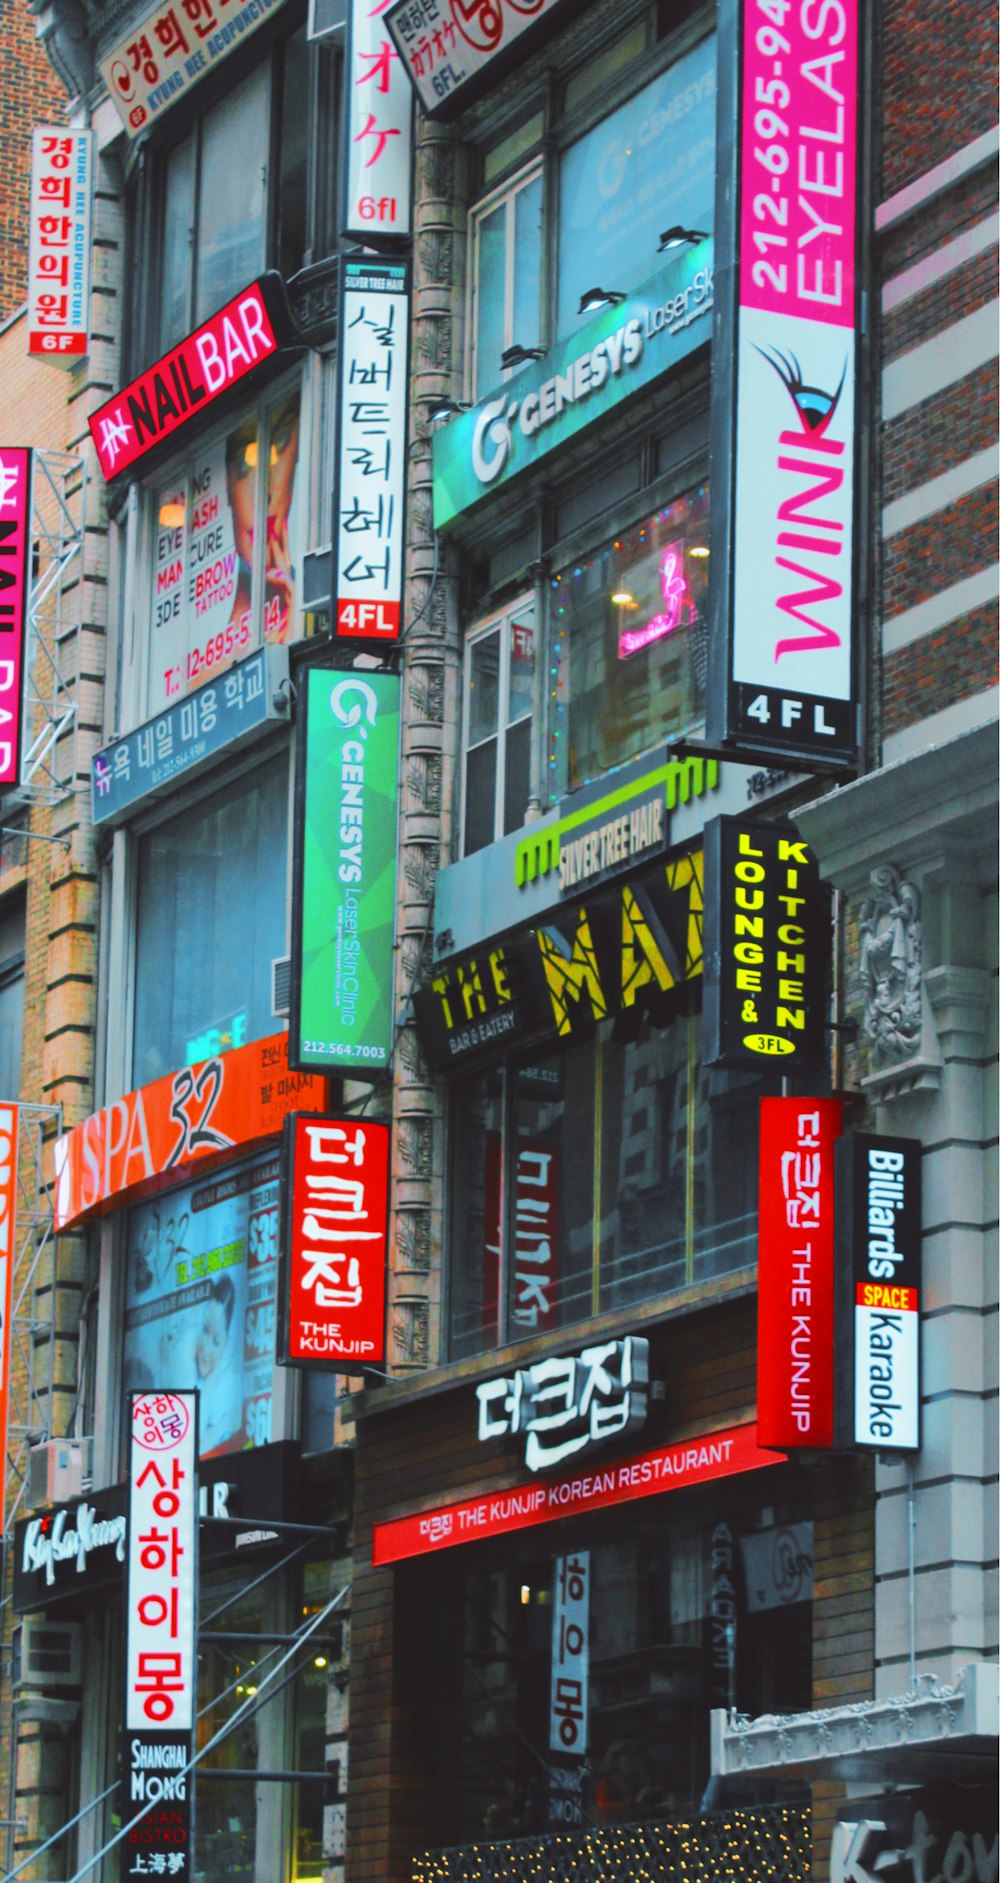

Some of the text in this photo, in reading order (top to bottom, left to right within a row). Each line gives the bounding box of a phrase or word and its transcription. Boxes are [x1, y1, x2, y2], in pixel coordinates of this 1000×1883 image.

[147, 70, 185, 112] KYUNG
[184, 49, 208, 79] HEE
[36, 137, 73, 325] 경희한의원
[72, 136, 87, 326] KYUNG HEE ACUPUNCTURE
[358, 197, 396, 223] 6fl
[346, 276, 404, 291] SILVER TREE HAIR
[42, 335, 73, 349] 6F
[128, 354, 205, 446] NAIL
[196, 297, 272, 393] BAR
[519, 318, 644, 436] GENESYS
[195, 580, 234, 619] TATTOO
[339, 607, 394, 631] 4FL
[96, 657, 264, 798] 뉴욕 네일 미용 학교
[338, 740, 366, 883] GENESYS
[560, 799, 663, 891] SILVER TREE HAIR
[734, 834, 765, 1023] LOUNGE &
[777, 840, 808, 1029] KITCHEN
[432, 946, 511, 1030] THE
[448, 1033, 471, 1055] BAR
[479, 1010, 515, 1041] EATERY
[304, 1040, 387, 1059] 212.564.7003
[757, 1036, 785, 1053] 3FL
[81, 1056, 236, 1210] SPA 32
[781, 1110, 821, 1229] 더큰집
[301, 1126, 383, 1307] 더큰집
[868, 1149, 904, 1278] Billiards
[300, 1321, 341, 1337] THE
[300, 1337, 375, 1354] KUNJIP
[791, 1243, 811, 1432] THE KUNJIP
[864, 1285, 909, 1309] SPACE
[476, 1336, 640, 1472] 더큰집
[869, 1313, 902, 1437] Karaoke
[419, 1440, 733, 1541] 더큰집 THE KUNJIP KOREAN RESTAURANT
[134, 1458, 186, 1722] 상하이몽
[129, 1852, 185, 1874] 上海夢
[130, 1829, 186, 1844] BISTRO
